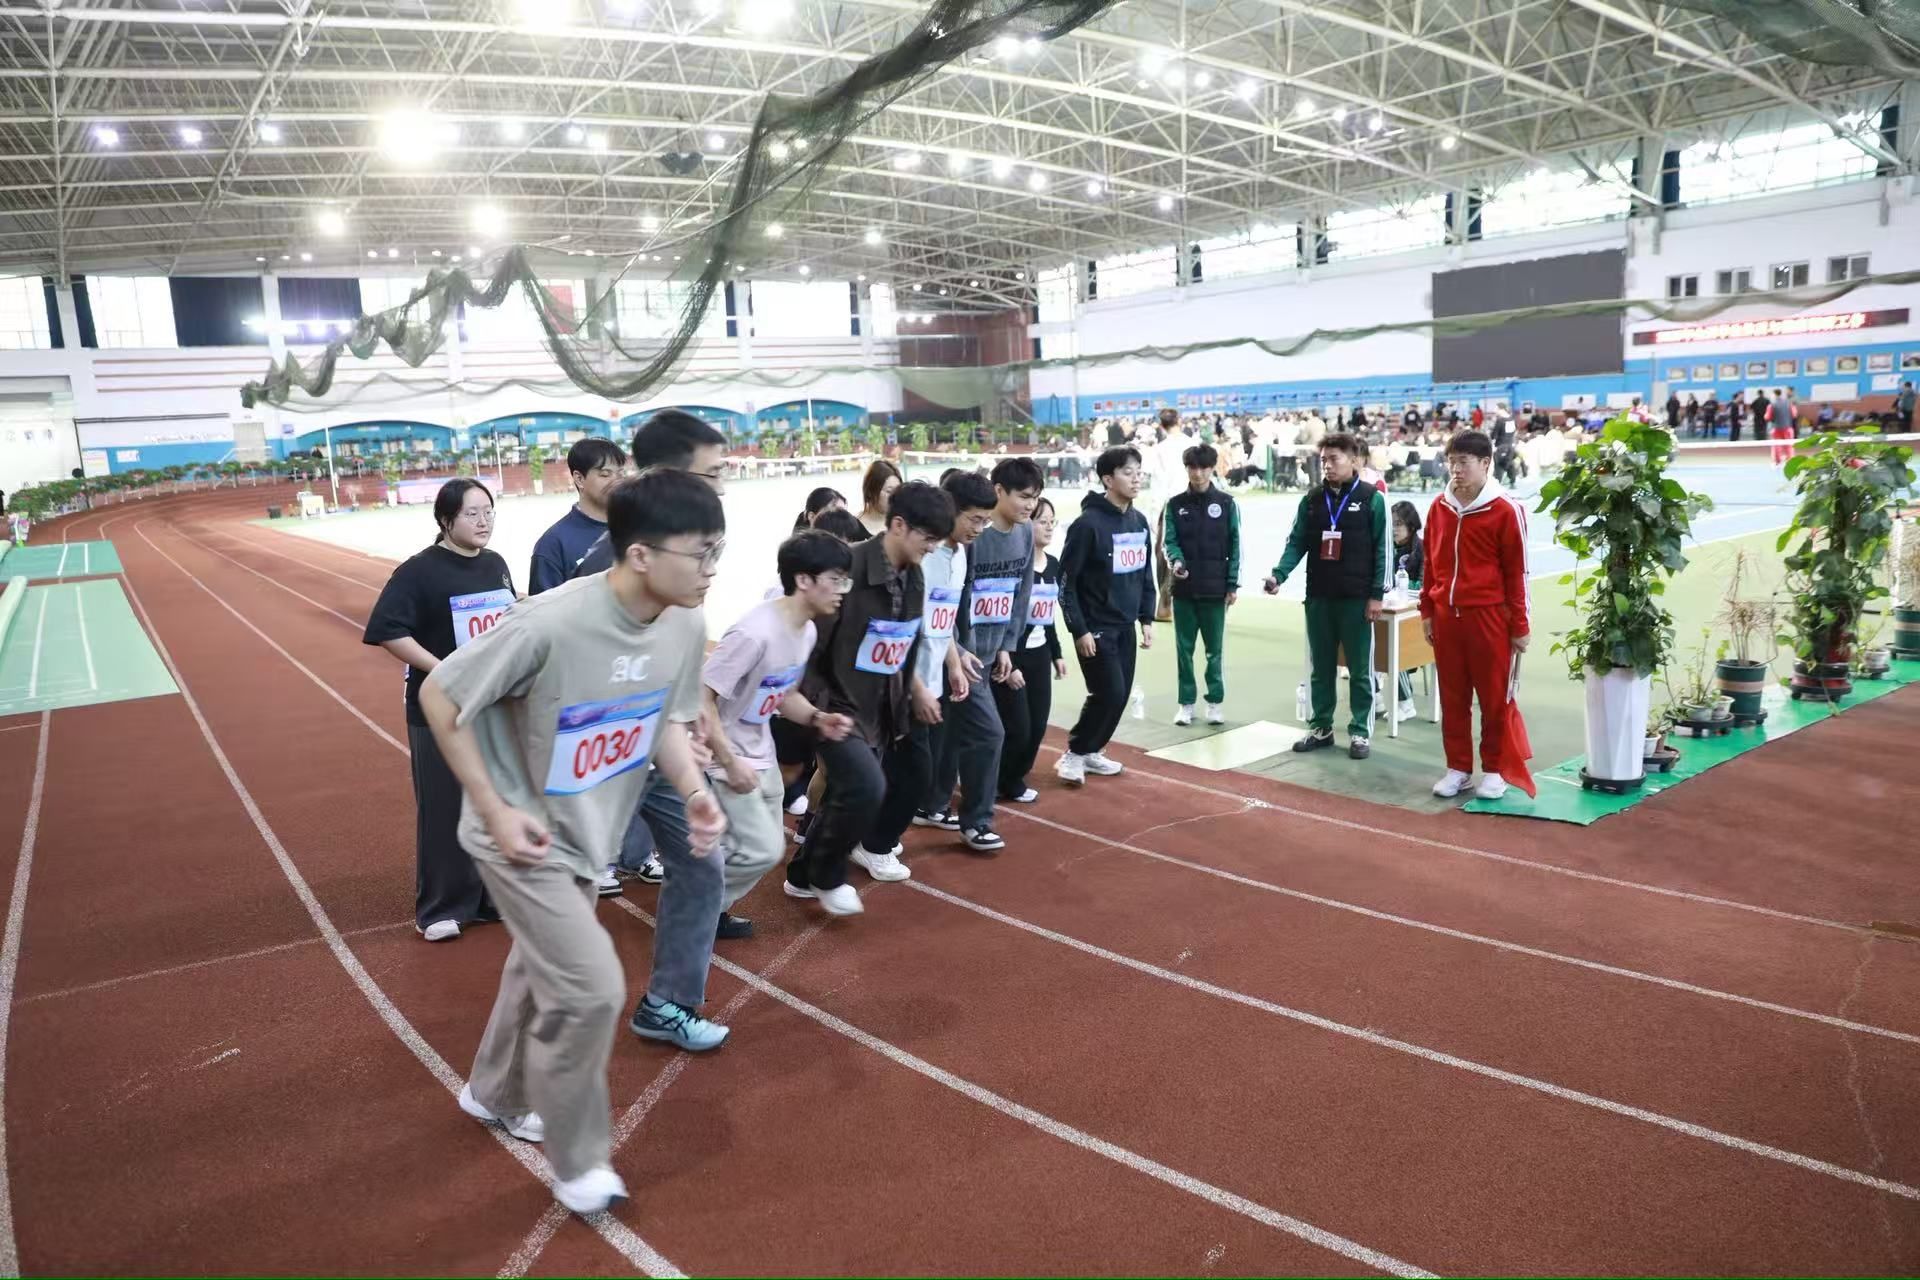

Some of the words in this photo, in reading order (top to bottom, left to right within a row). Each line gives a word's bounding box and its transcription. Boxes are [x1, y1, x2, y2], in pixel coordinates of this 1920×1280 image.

[974, 596, 1009, 617] 0018
[1031, 600, 1056, 618] 001
[931, 607, 956, 630] 001
[573, 725, 643, 779] 0030
